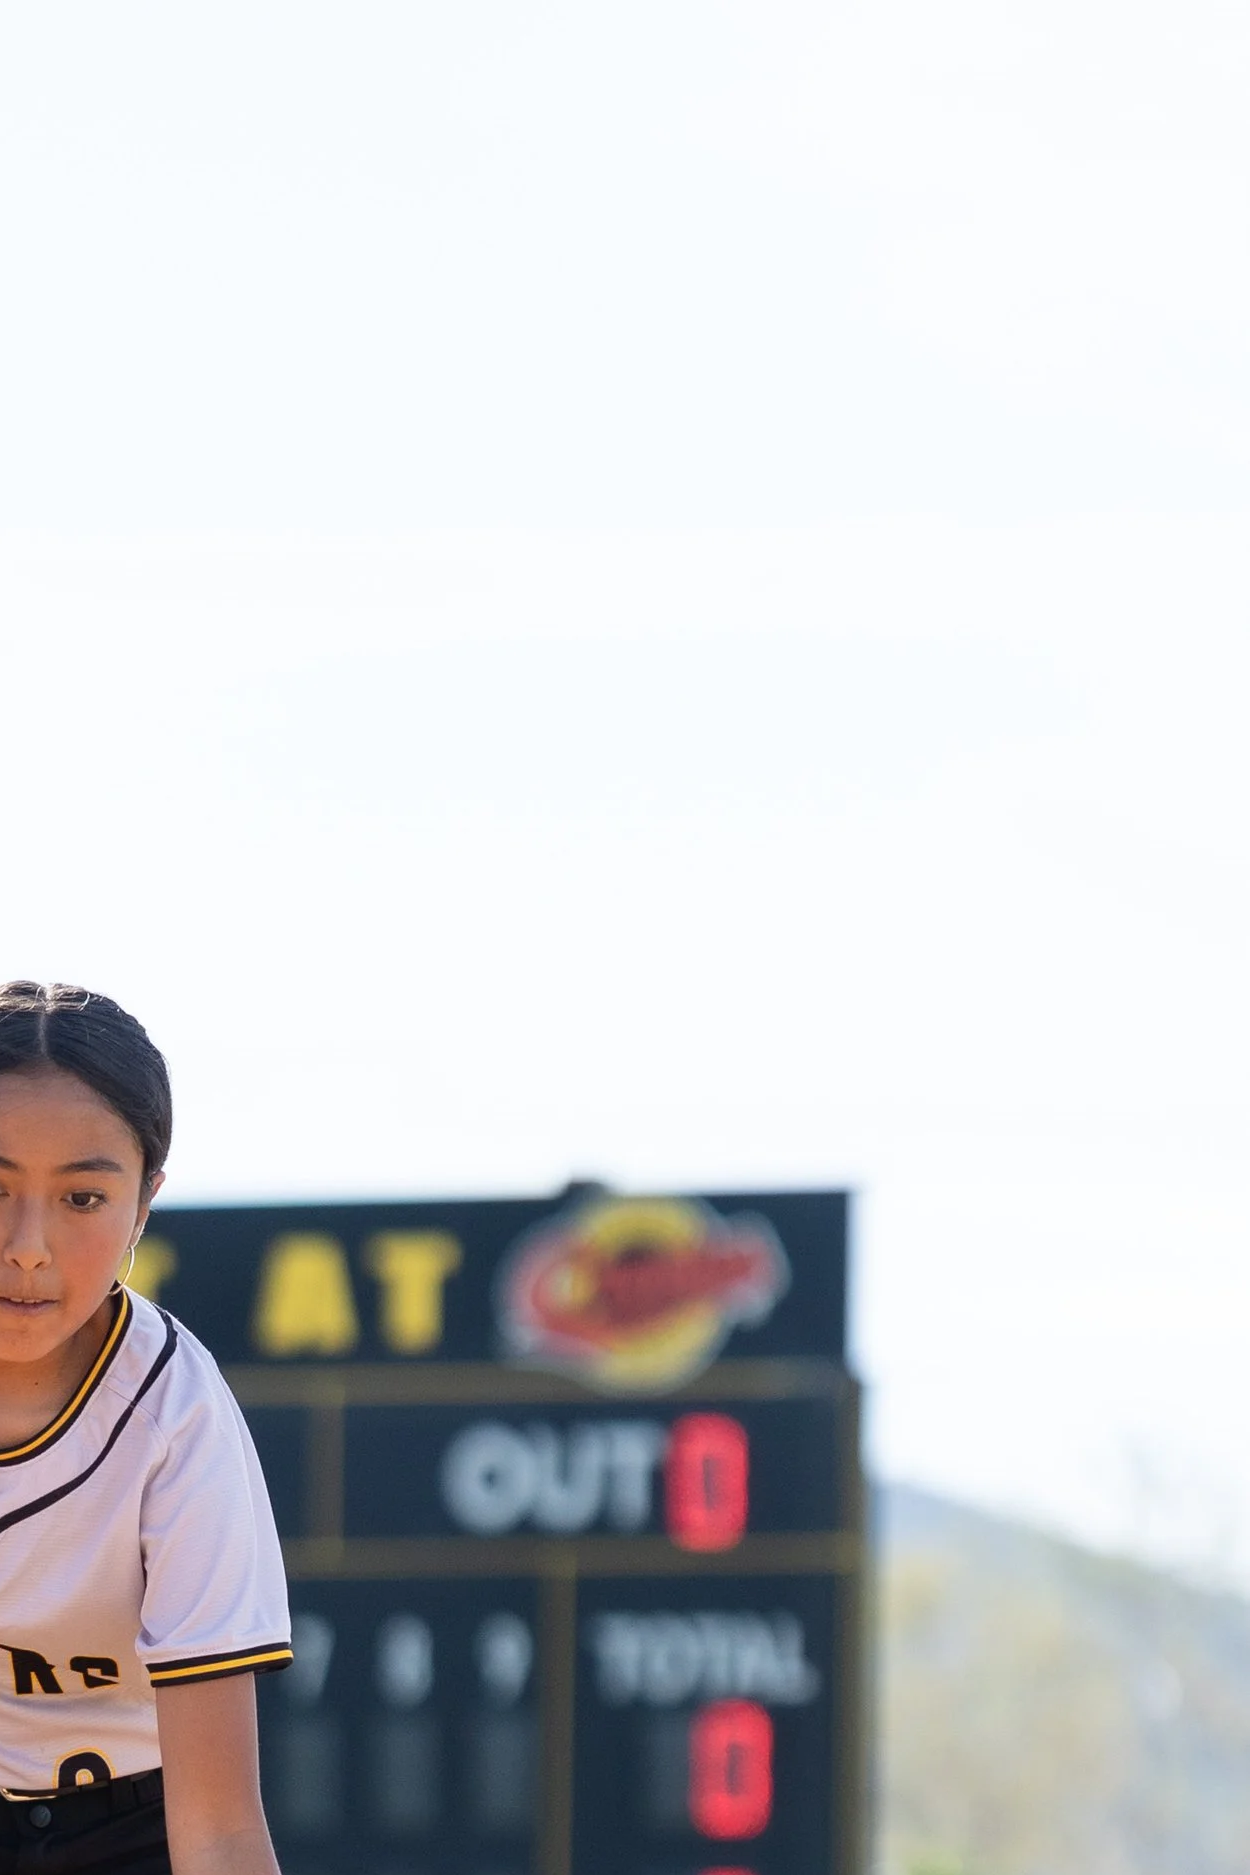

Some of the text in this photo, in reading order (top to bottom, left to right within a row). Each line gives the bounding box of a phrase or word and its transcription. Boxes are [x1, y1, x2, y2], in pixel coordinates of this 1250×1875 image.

[445, 1422, 660, 1534] OUT
[663, 1411, 749, 1552] 0
[590, 1611, 820, 1704] TOTAL
[688, 1697, 775, 1840] 0
